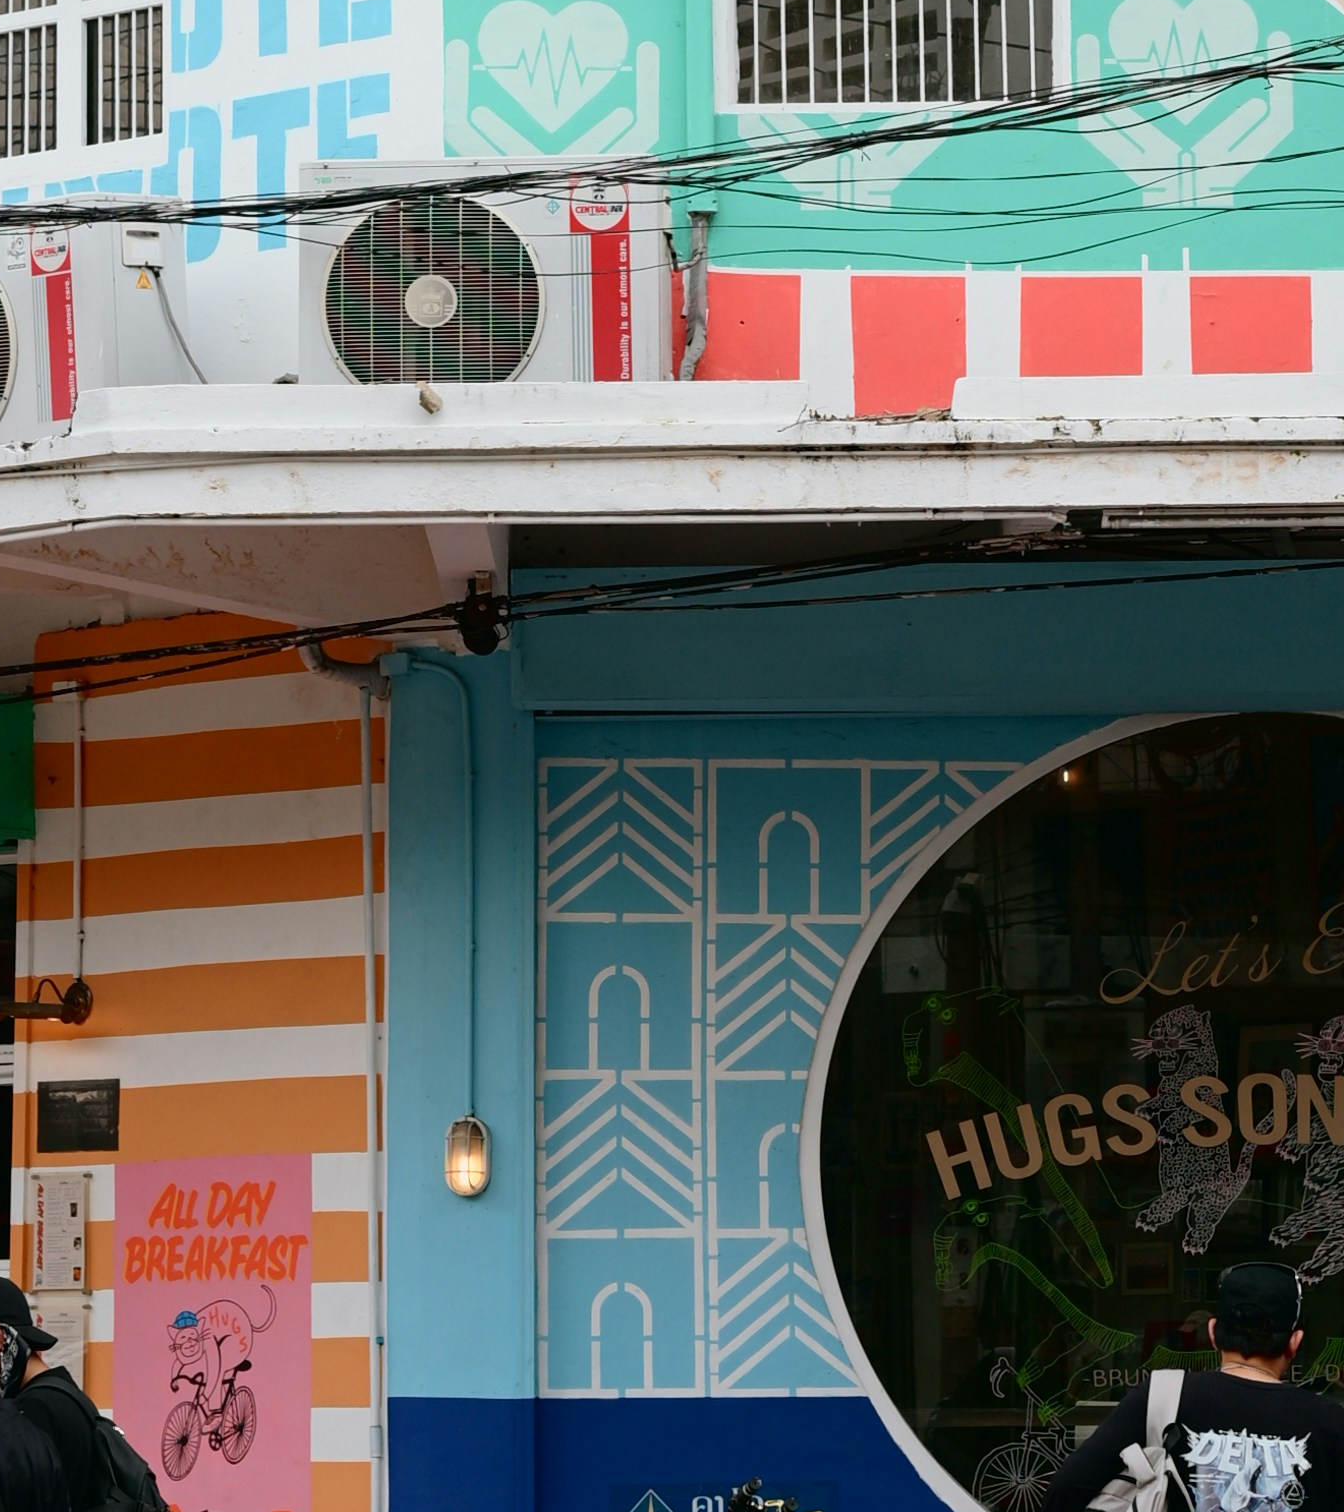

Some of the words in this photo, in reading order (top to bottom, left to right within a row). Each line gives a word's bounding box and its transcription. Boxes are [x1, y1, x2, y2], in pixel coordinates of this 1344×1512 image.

[1099, 912, 1282, 1005] Let's
[925, 1083, 1158, 1201] HUGS
[148, 1182, 199, 1230] ALL
[205, 1180, 277, 1229] DAY
[122, 1234, 309, 1285] BREAKFAST
[1180, 1425, 1312, 1477] DELTA
